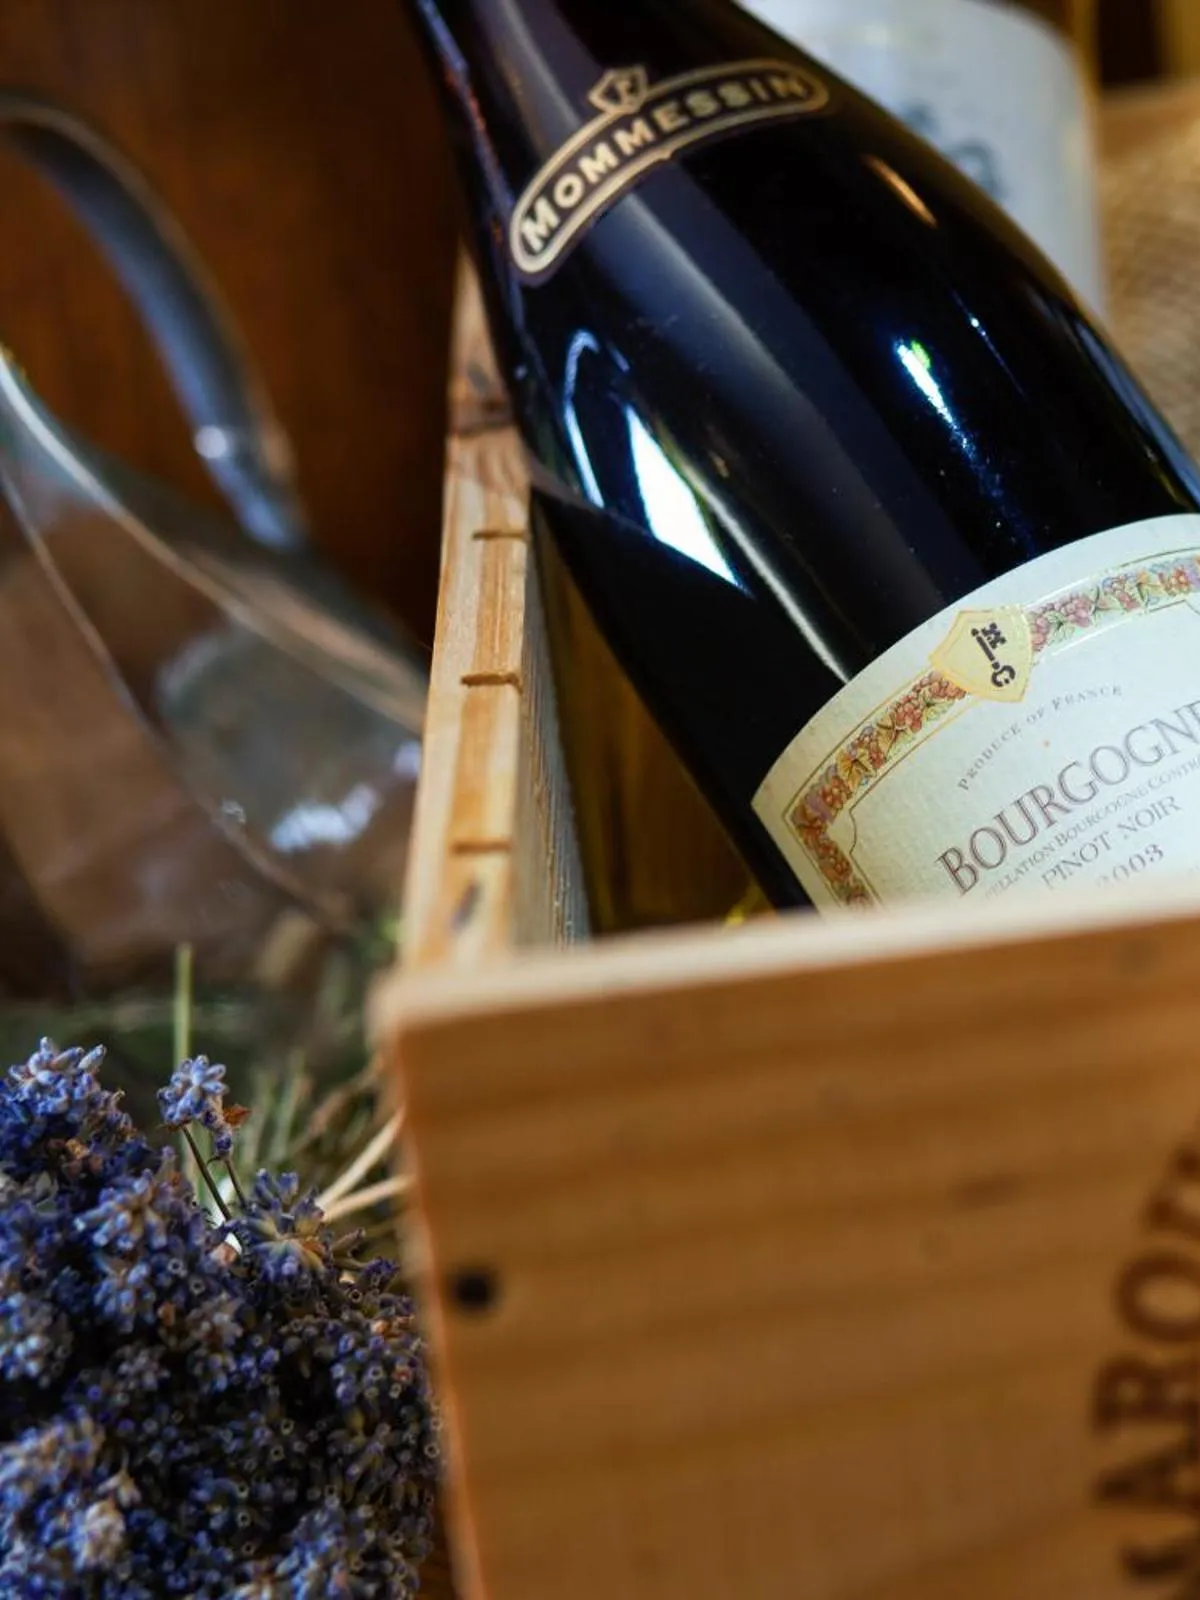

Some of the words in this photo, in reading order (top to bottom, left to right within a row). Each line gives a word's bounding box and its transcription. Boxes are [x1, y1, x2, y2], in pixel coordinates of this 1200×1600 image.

[520, 75, 809, 251] MOMMESSIN
[957, 722, 1022, 791] PRODUCE
[1026, 706, 1046, 724] OF
[1052, 685, 1123, 712] FRANCE
[984, 839, 1056, 898] ELLATION
[1054, 782, 1149, 848] BOURGOGNE
[1040, 831, 1113, 889] PINOT
[1117, 795, 1182, 840] NOIR
